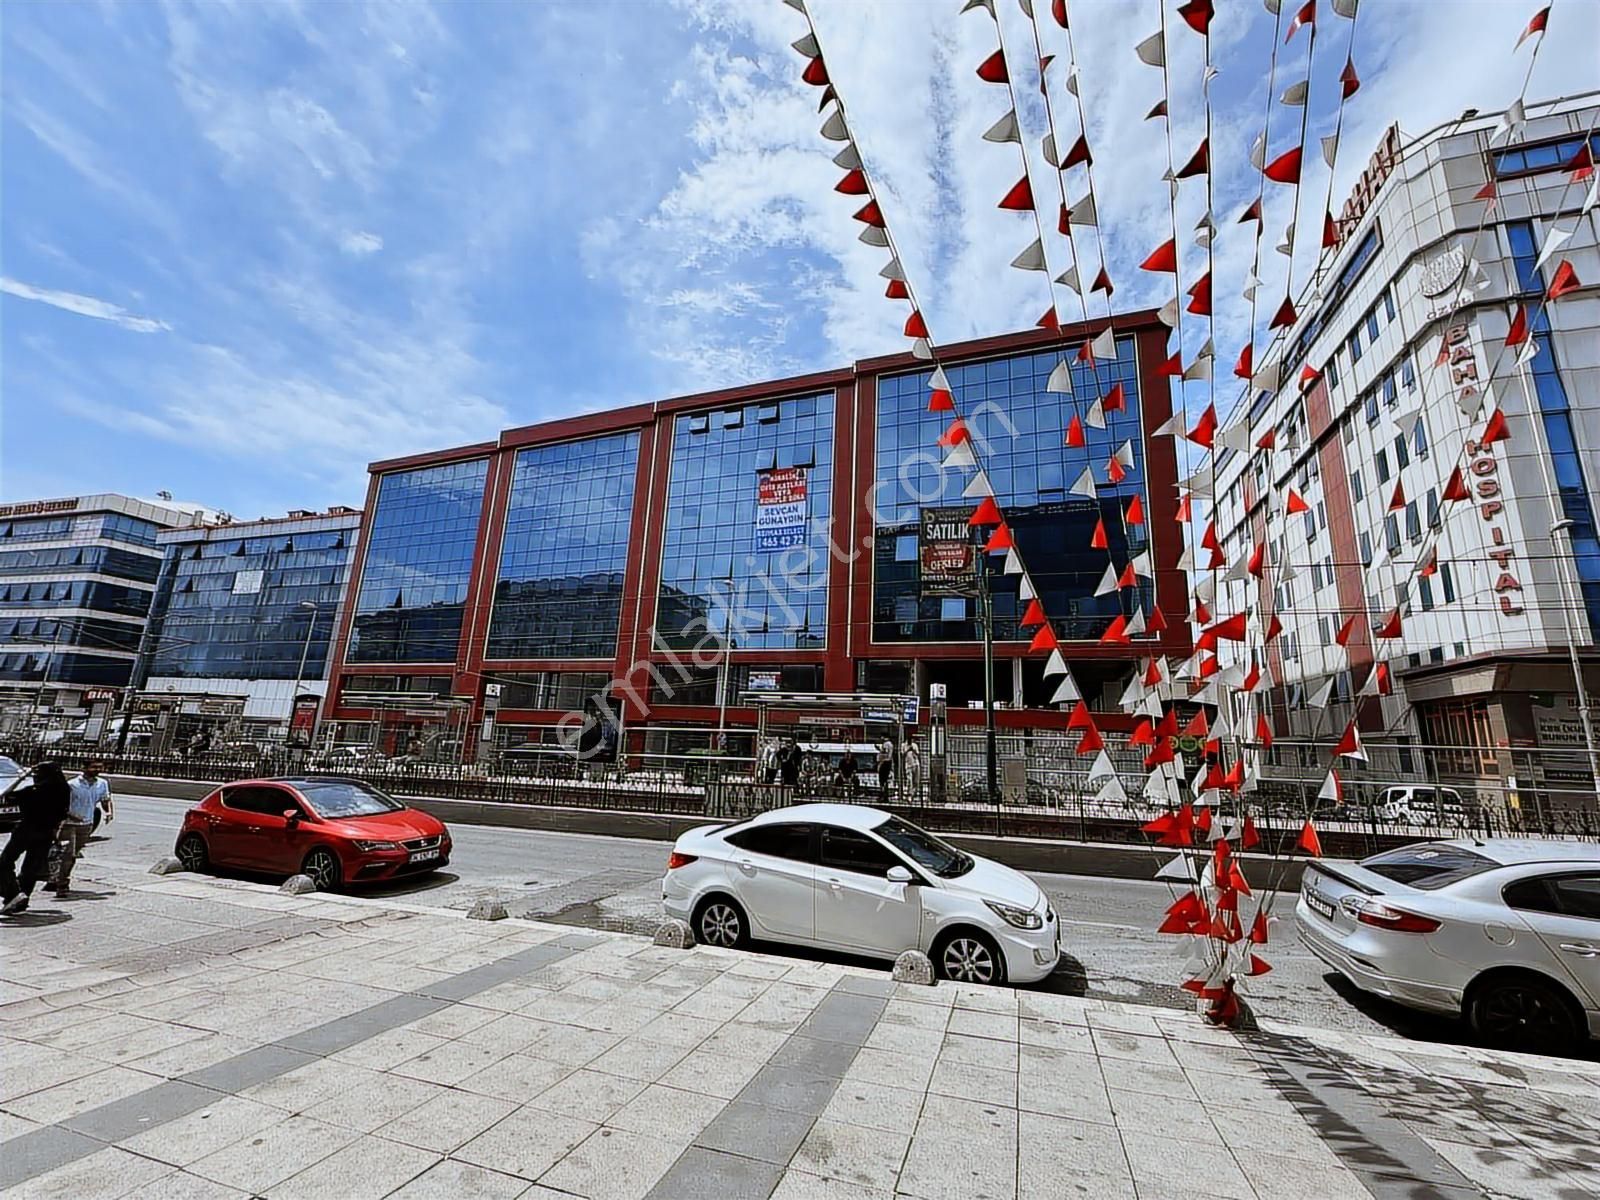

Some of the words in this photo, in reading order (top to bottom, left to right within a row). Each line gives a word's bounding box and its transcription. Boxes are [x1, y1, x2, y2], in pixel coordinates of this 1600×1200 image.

[1446, 323, 1484, 421] BAHA
[765, 505, 798, 516] SEVCAN
[926, 523, 970, 540] SATILIK
[1465, 438, 1524, 617] HOSPITAL
[793, 534, 804, 545] 72
